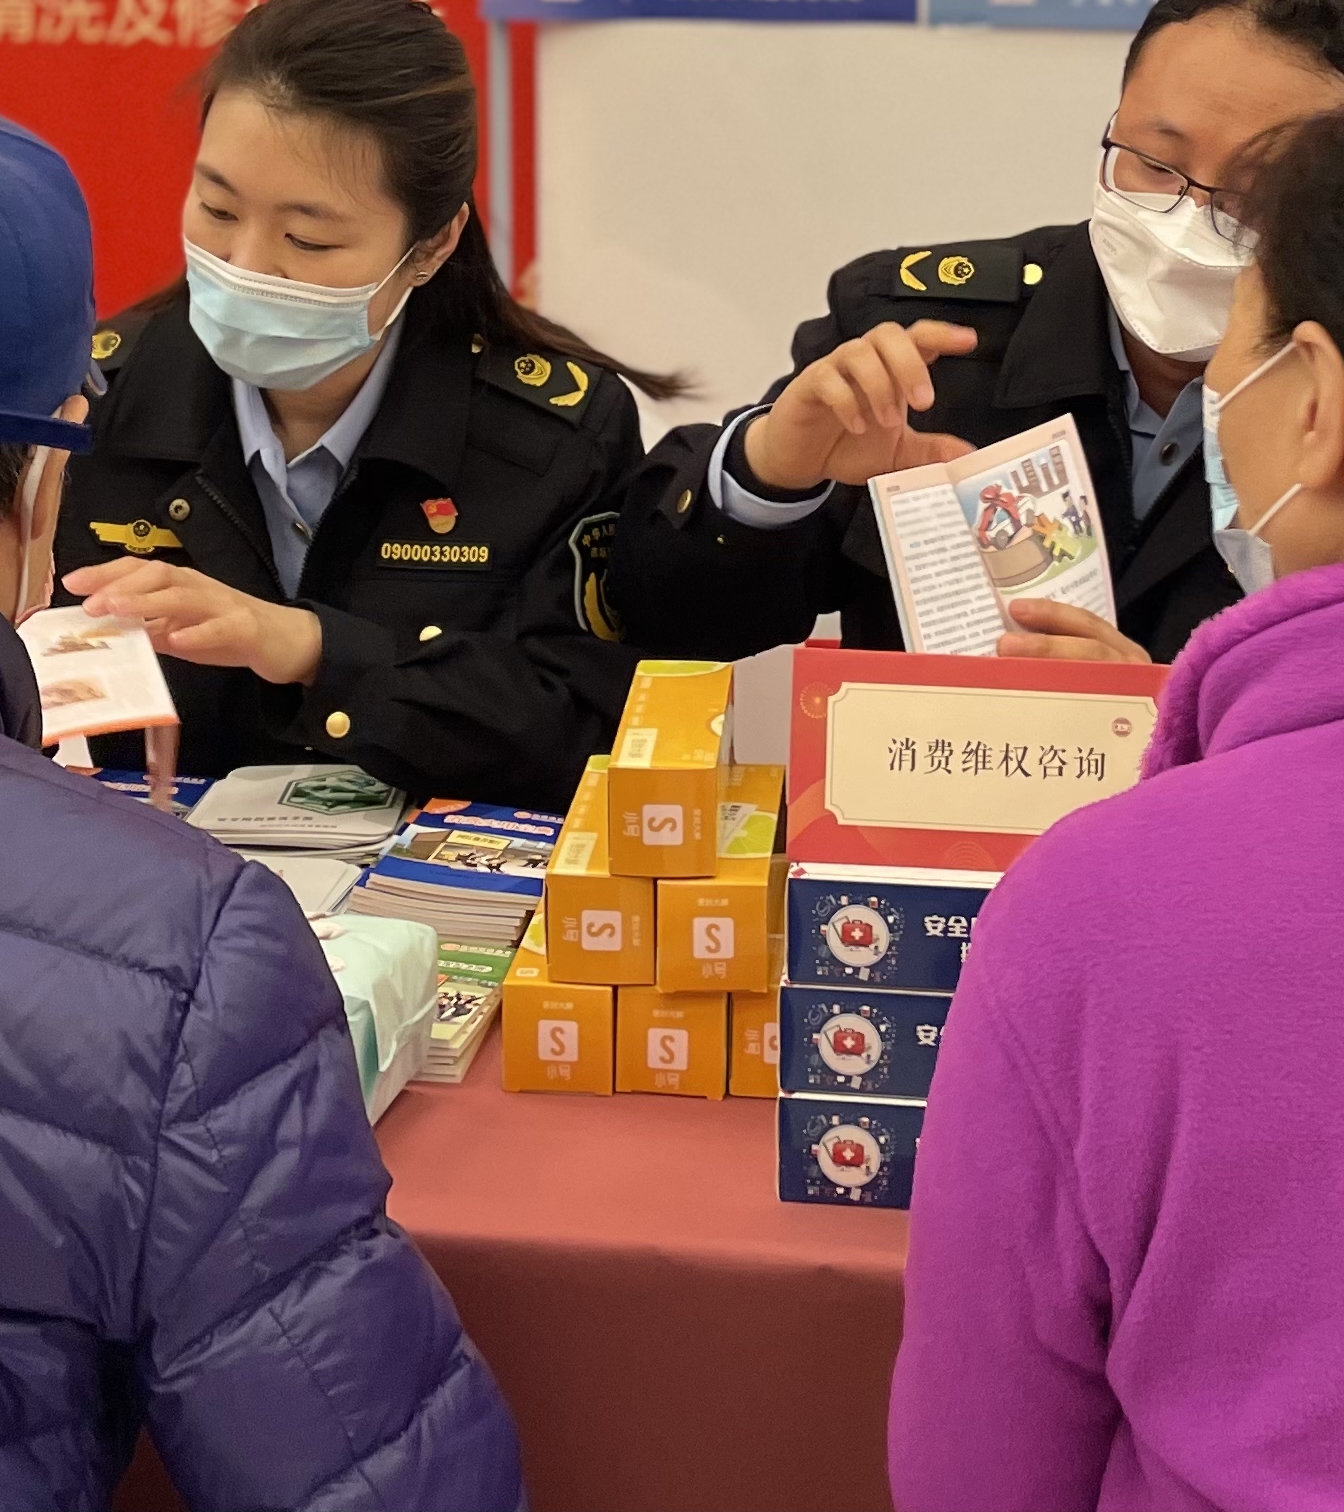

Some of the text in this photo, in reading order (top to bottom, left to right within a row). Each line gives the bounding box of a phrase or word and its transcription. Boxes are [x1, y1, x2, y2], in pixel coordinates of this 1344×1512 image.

[380, 541, 490, 564] 09000330309
[886, 736, 1107, 782] 消费维权咨询
[705, 923, 722, 954] S
[923, 914, 976, 938] 安全
[549, 1026, 566, 1056] S
[658, 1034, 676, 1065] S
